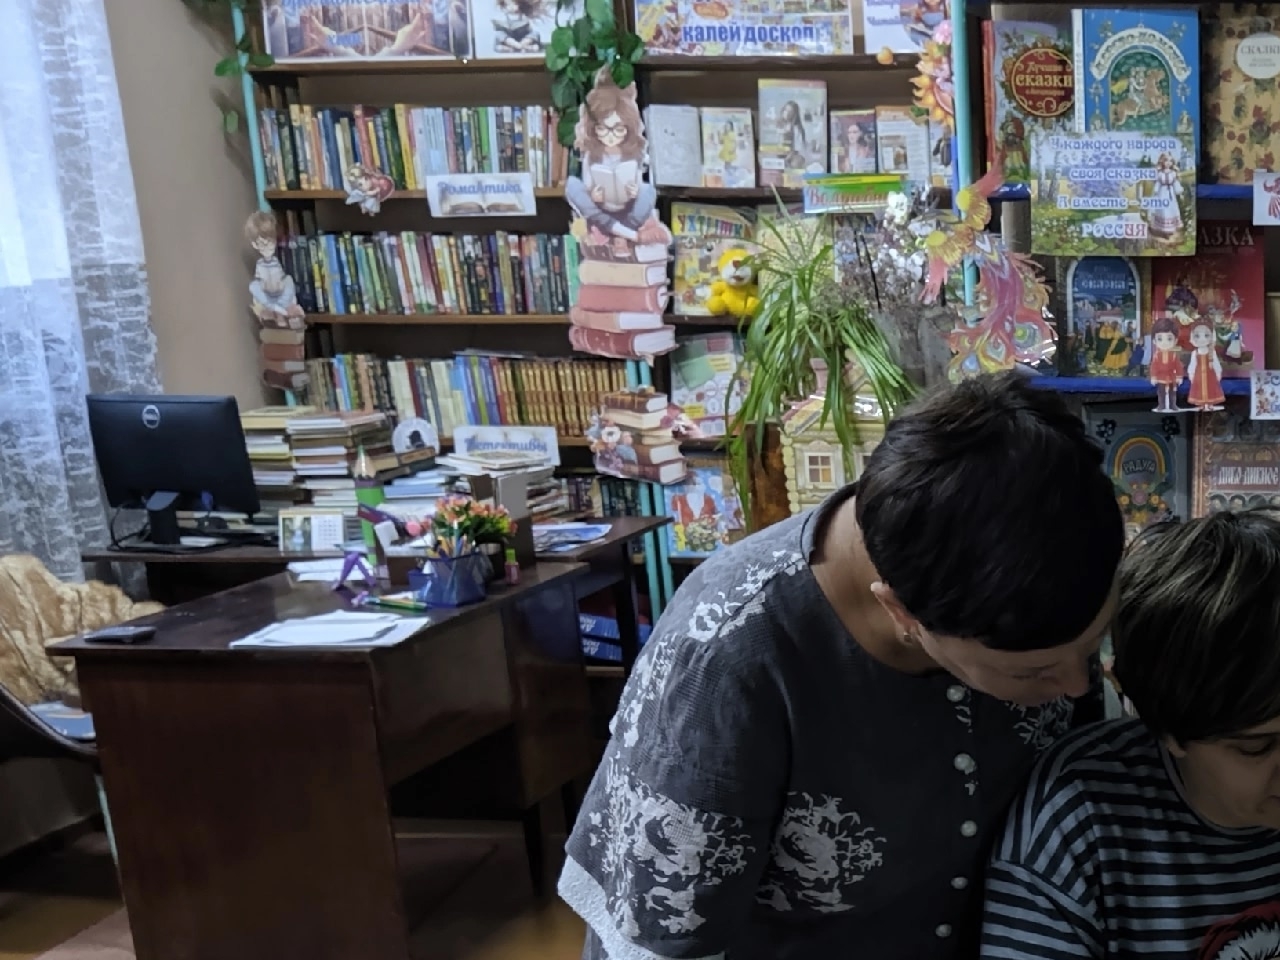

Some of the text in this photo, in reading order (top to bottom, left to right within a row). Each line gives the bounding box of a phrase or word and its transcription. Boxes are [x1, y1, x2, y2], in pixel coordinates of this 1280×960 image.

[1062, 138, 1123, 151] каждого
[1127, 139, 1176, 151] народа
[1070, 169, 1157, 181] своя сказка
[1072, 198, 1127, 209] вместе
[1142, 198, 1170, 208] это
[1082, 223, 1147, 237] РОССИЯ
[1198, 227, 1255, 246] АЗКА
